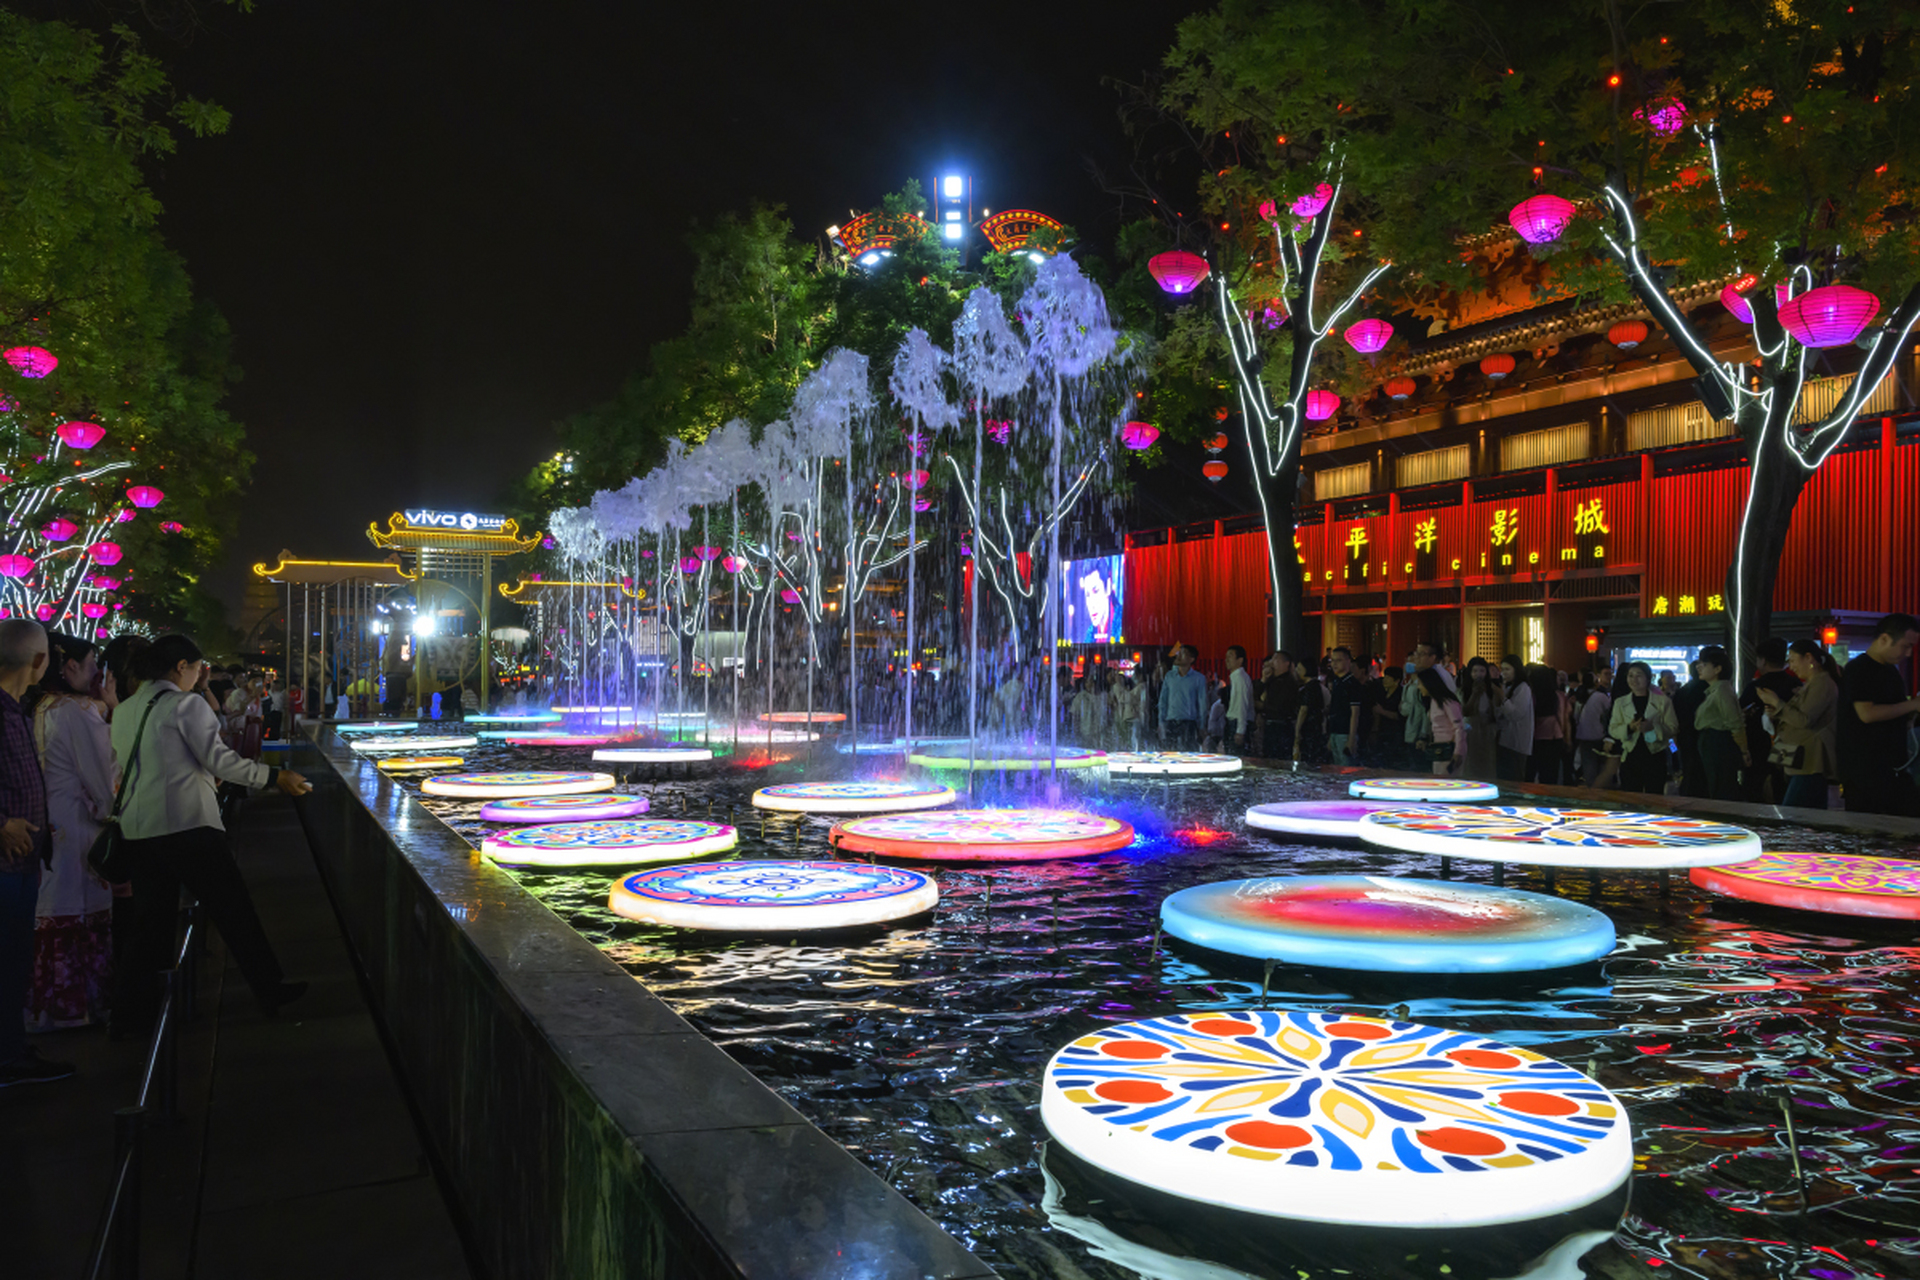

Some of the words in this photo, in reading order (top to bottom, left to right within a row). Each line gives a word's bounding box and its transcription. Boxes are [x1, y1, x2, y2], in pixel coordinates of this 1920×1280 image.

[405, 509, 457, 526] vivo
[1293, 498, 1609, 564] 平洋影城
[1302, 561, 1414, 582] acific
[1451, 545, 1605, 572] cinema
